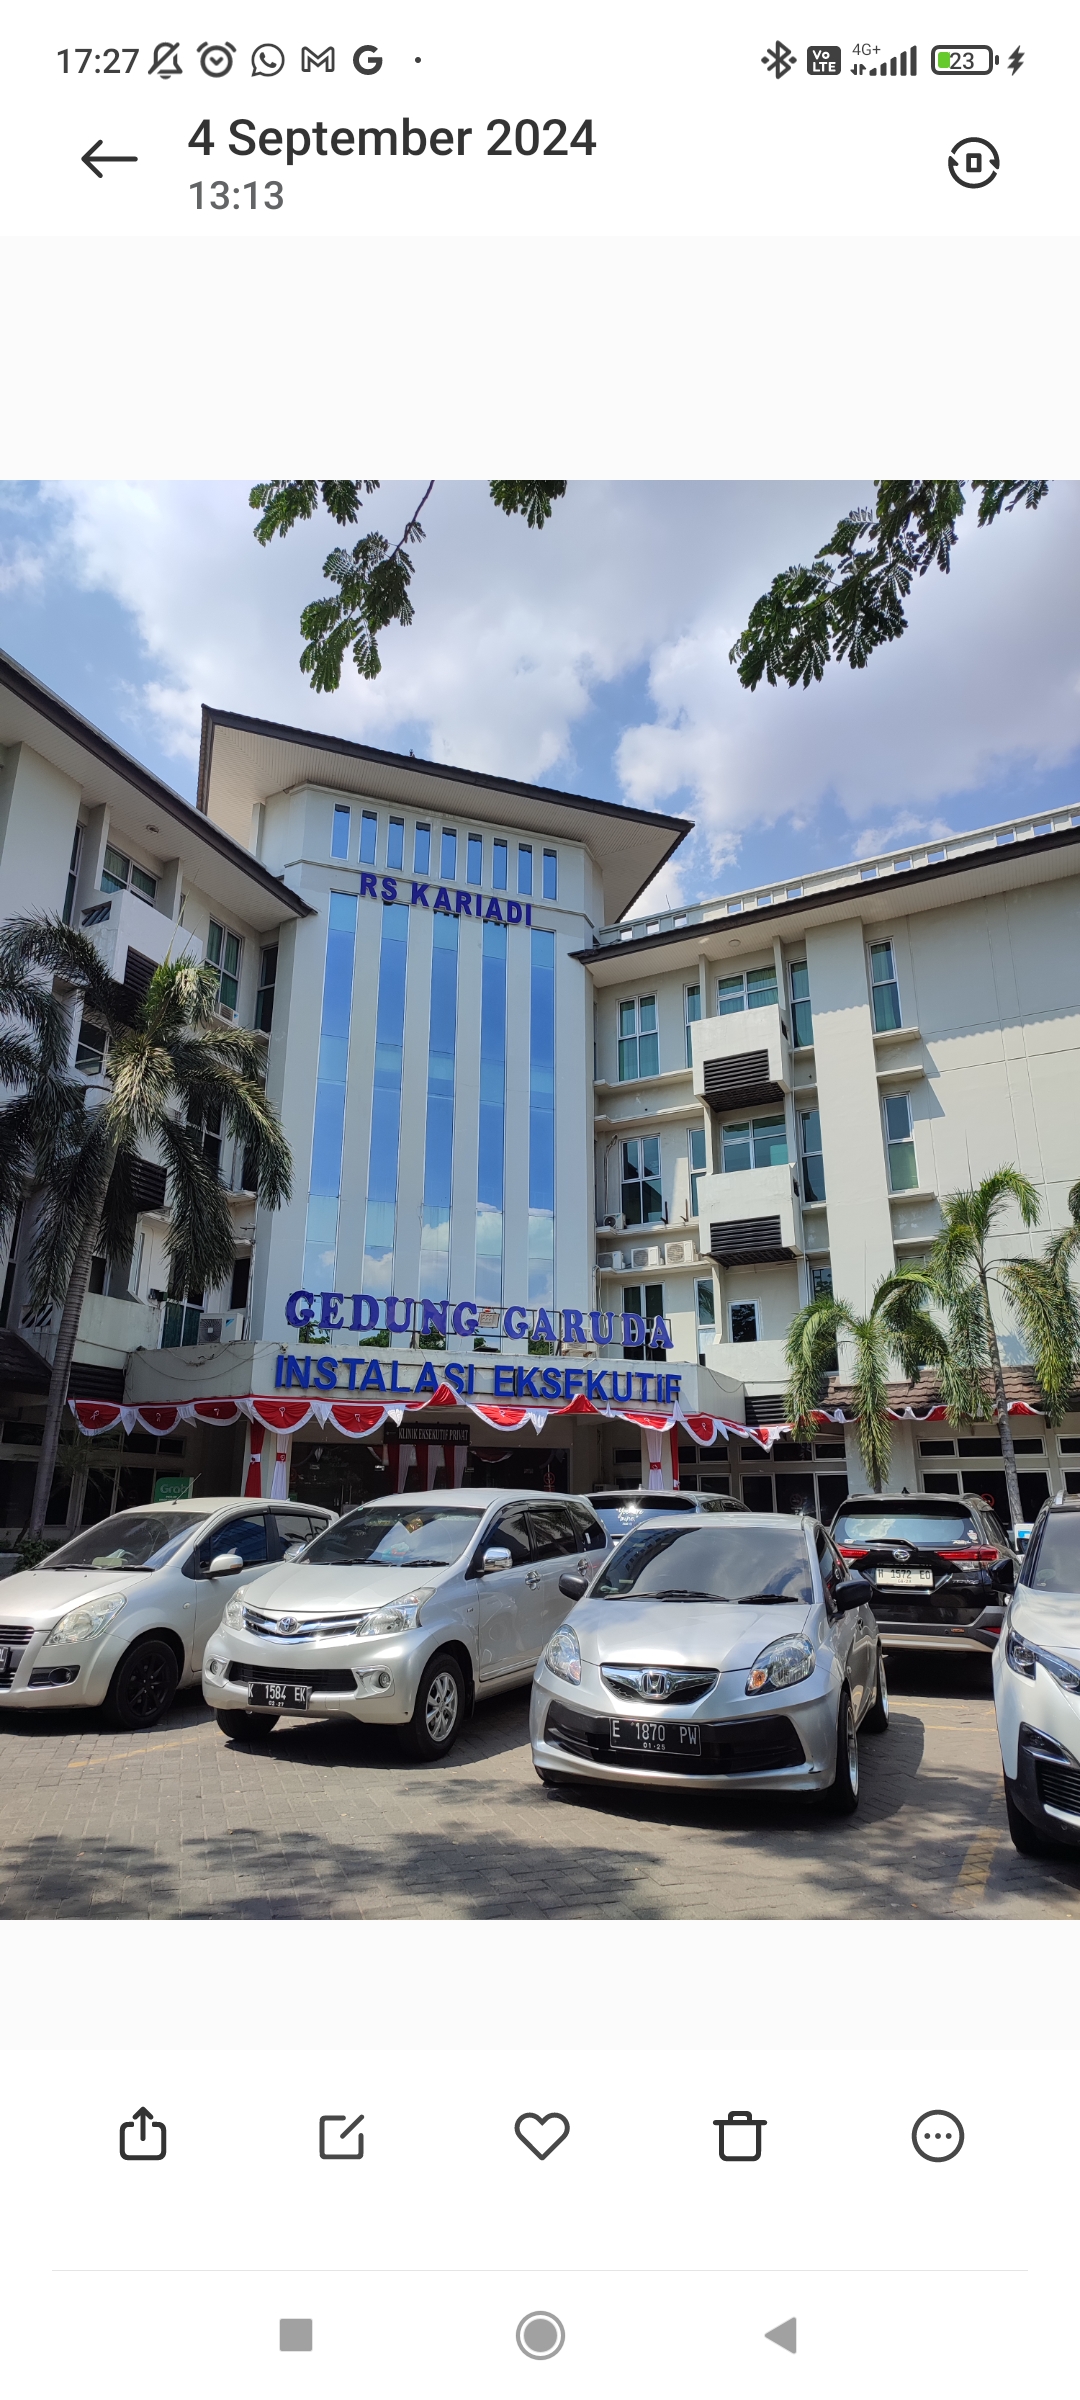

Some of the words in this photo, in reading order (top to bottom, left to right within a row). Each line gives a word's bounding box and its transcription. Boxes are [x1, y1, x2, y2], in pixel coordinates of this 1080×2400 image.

[812, 49, 831, 60] Vo
[852, 43, 881, 56] 4G+
[57, 48, 140, 74] 17:27
[812, 61, 837, 72] LTE
[949, 52, 975, 70] 23
[187, 119, 214, 156] 4
[228, 116, 473, 166] September
[486, 119, 597, 156] 2024
[189, 180, 284, 210] 13:13
[359, 872, 398, 901] RS
[411, 881, 532, 927] KARIADI
[285, 1290, 479, 1337] GEDUNG
[503, 1305, 674, 1349] GARUDA
[275, 1354, 475, 1396] INSTALASI
[494, 1365, 682, 1404] EKSEKUTIF
[398, 1427, 418, 1440] KLINIK
[160, 1484, 187, 1494] Grab
[890, 1569, 912, 1579] 1572
[248, 1683, 254, 1698] K
[265, 1684, 287, 1700] 1584
[294, 1687, 306, 1702] EK
[612, 1720, 620, 1738] E
[635, 1722, 666, 1742] 1870
[679, 1726, 697, 1745] PW
